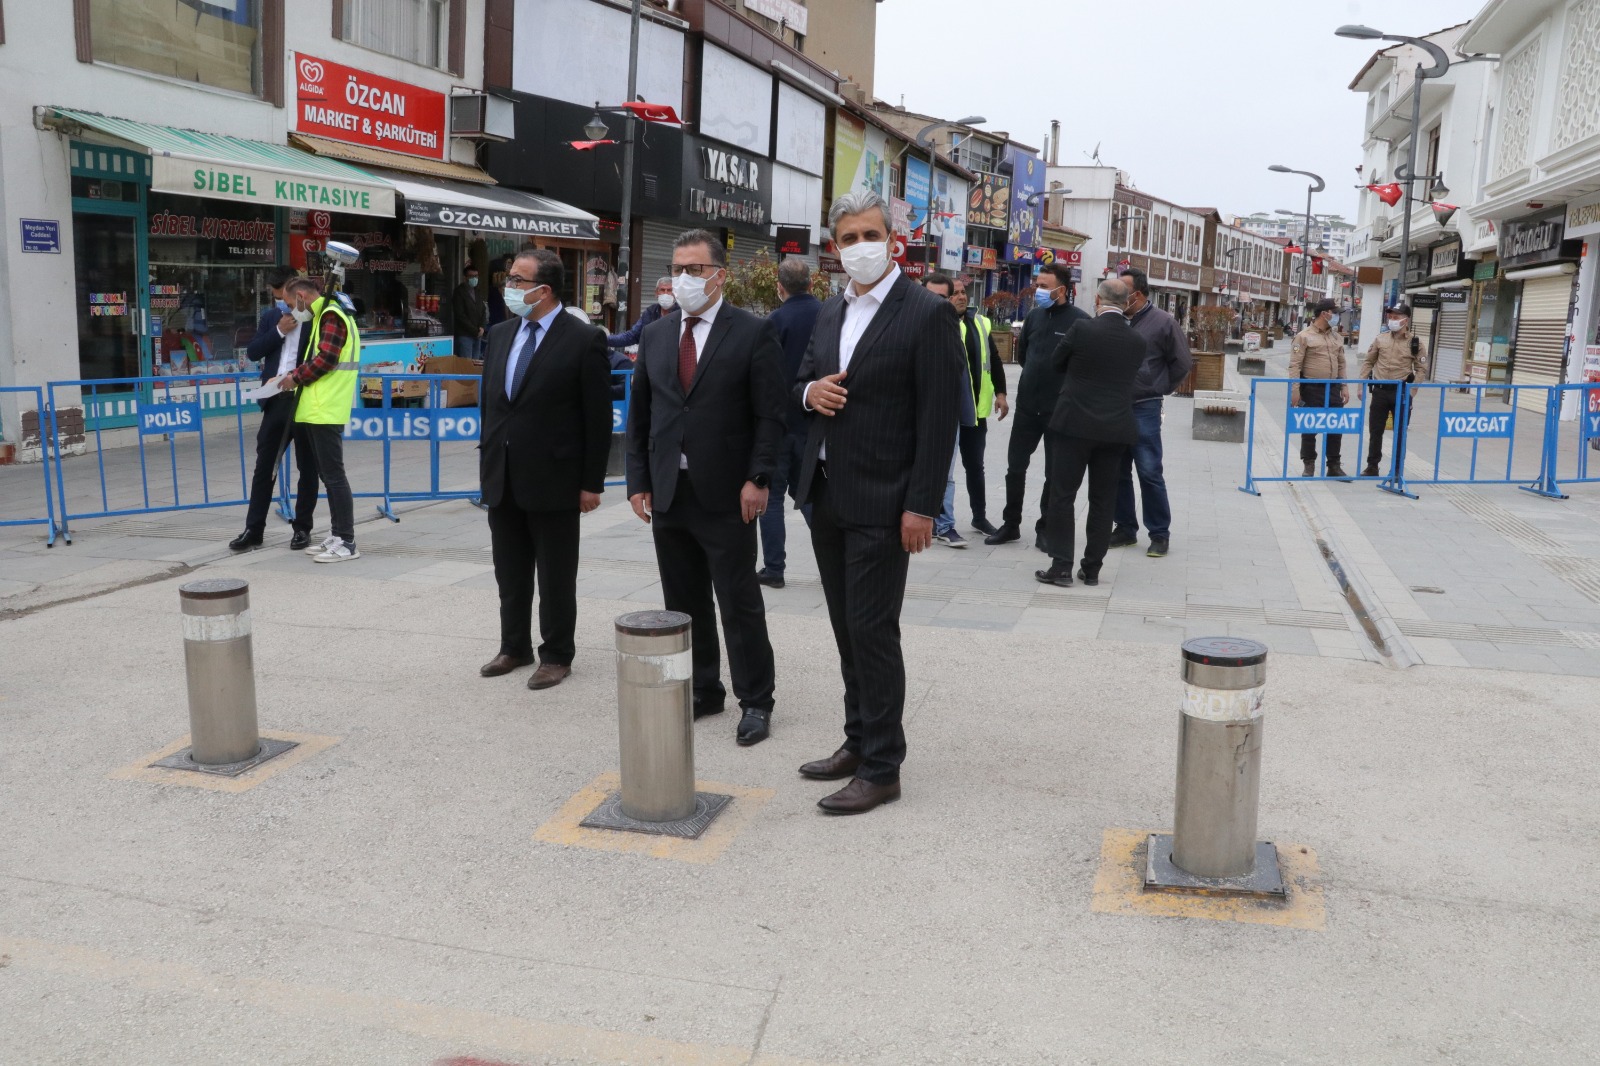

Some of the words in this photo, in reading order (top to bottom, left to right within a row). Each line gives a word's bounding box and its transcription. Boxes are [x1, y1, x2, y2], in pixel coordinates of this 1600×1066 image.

[345, 75, 405, 117] ÖZCAN
[304, 104, 359, 132] MARKET
[362, 117, 372, 135] &
[375, 120, 437, 149] ŞARKÜTERİ
[193, 167, 257, 197] SİBEL
[275, 180, 371, 209] KIRTASİYE
[25, 224, 45, 233] Meydan
[151, 209, 198, 237] SİBEL
[201, 216, 276, 242] KIRTASİYE
[438, 207, 507, 229] ÖZCAN
[512, 217, 579, 235] MARKET
[30, 231, 52, 239] Caddesi
[228, 246, 243, 255] TEL:
[244, 247, 256, 256] 212
[256, 248, 264, 256] 12
[90, 291, 127, 303] RENKLİ
[90, 304, 128, 316] FOTOKOPİ
[144, 407, 192, 429] POLİS
[344, 412, 430, 438] POLİS
[438, 416, 481, 438] PO
[1293, 412, 1360, 430] YOZGAT
[1444, 416, 1510, 433] YOZGAT
